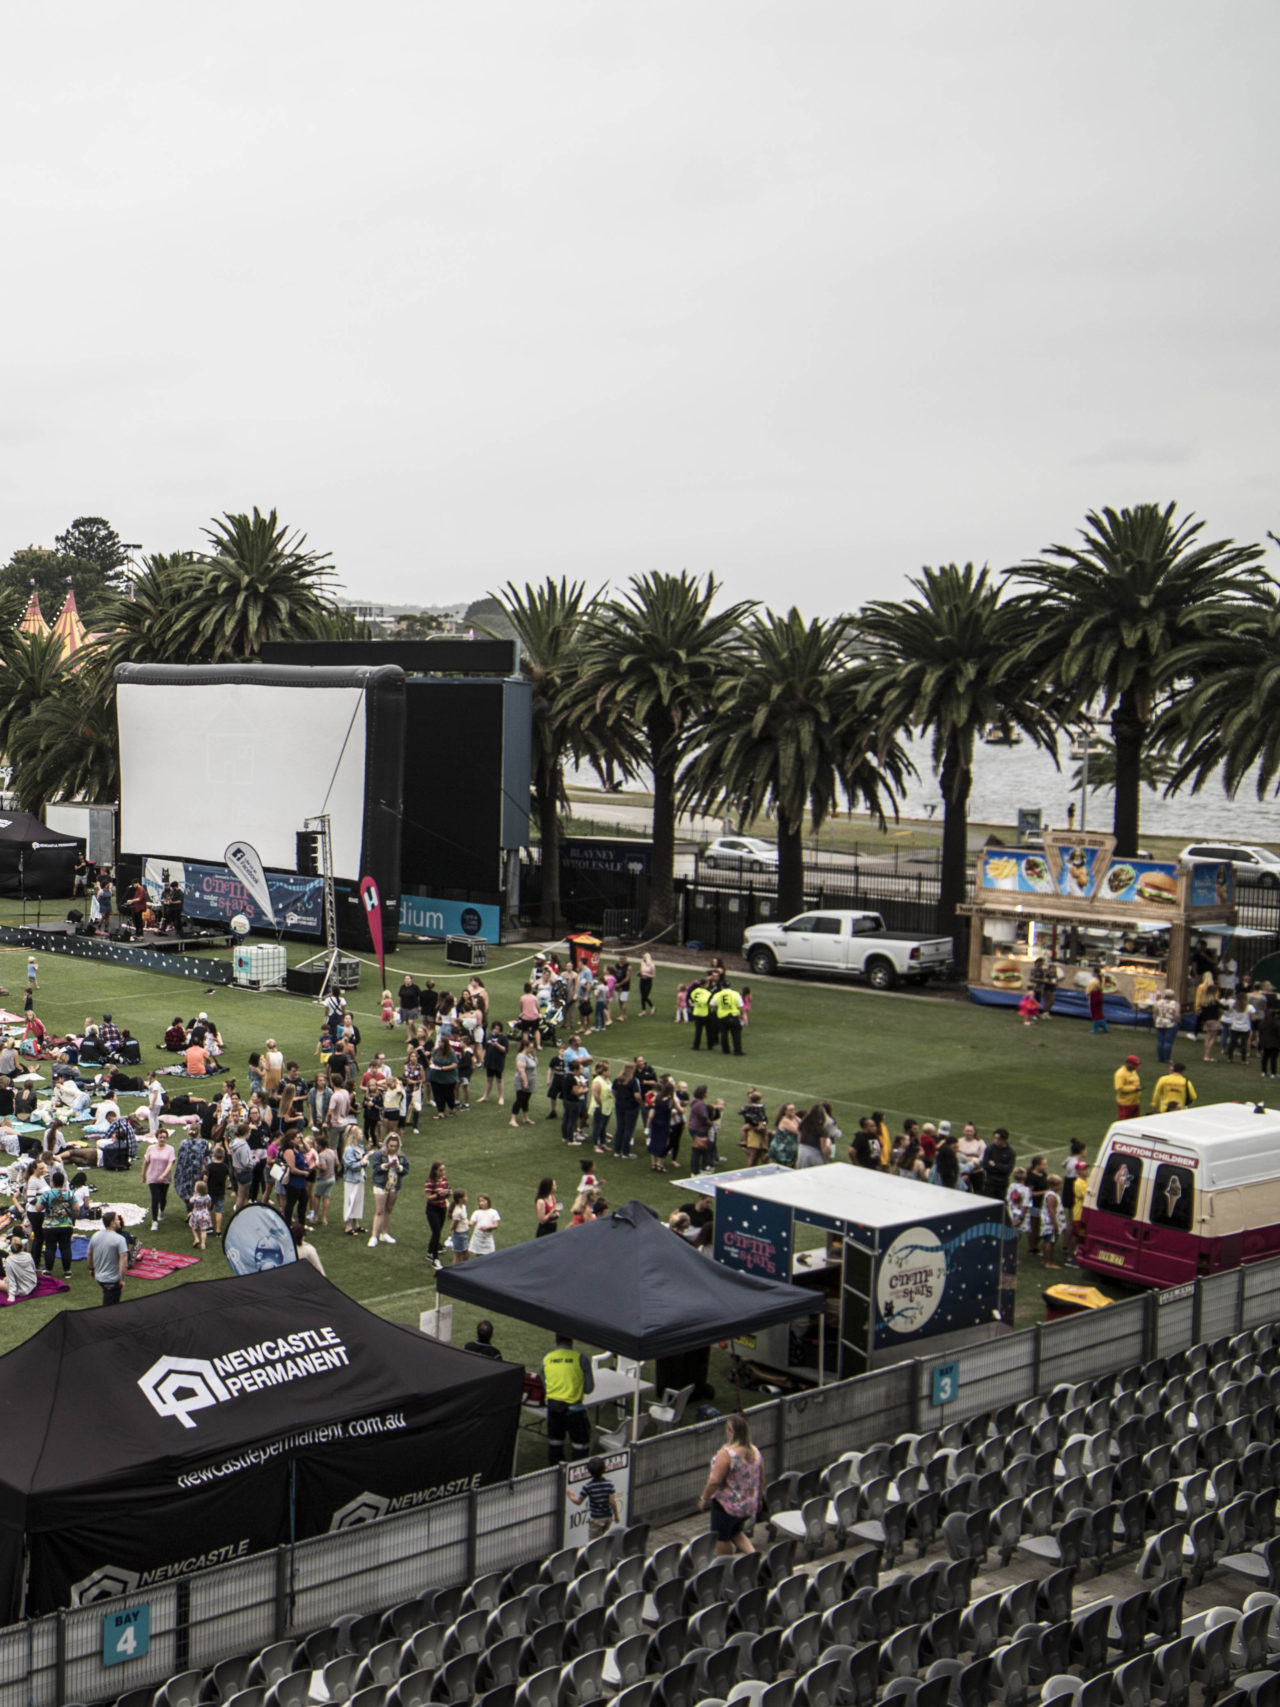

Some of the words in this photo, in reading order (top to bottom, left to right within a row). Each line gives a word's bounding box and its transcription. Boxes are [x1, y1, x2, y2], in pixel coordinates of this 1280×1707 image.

[218, 897, 255, 918] stars
[399, 901, 444, 930] dium
[1116, 1143, 1152, 1158] CAUTION
[1153, 1151, 1195, 1167] CHILDREN
[739, 1250, 776, 1274] stars
[902, 1285, 933, 1303] stars
[213, 1326, 341, 1377] NEWCASTLE
[224, 1345, 350, 1398] PERMANENT
[939, 1364, 954, 1377] BAY
[940, 1377, 951, 1399] 3
[389, 1473, 482, 1512] NEWCASTLE
[140, 1538, 250, 1586] NEWCASTLE
[115, 1609, 140, 1628] BAY
[116, 1625, 137, 1655] 4
